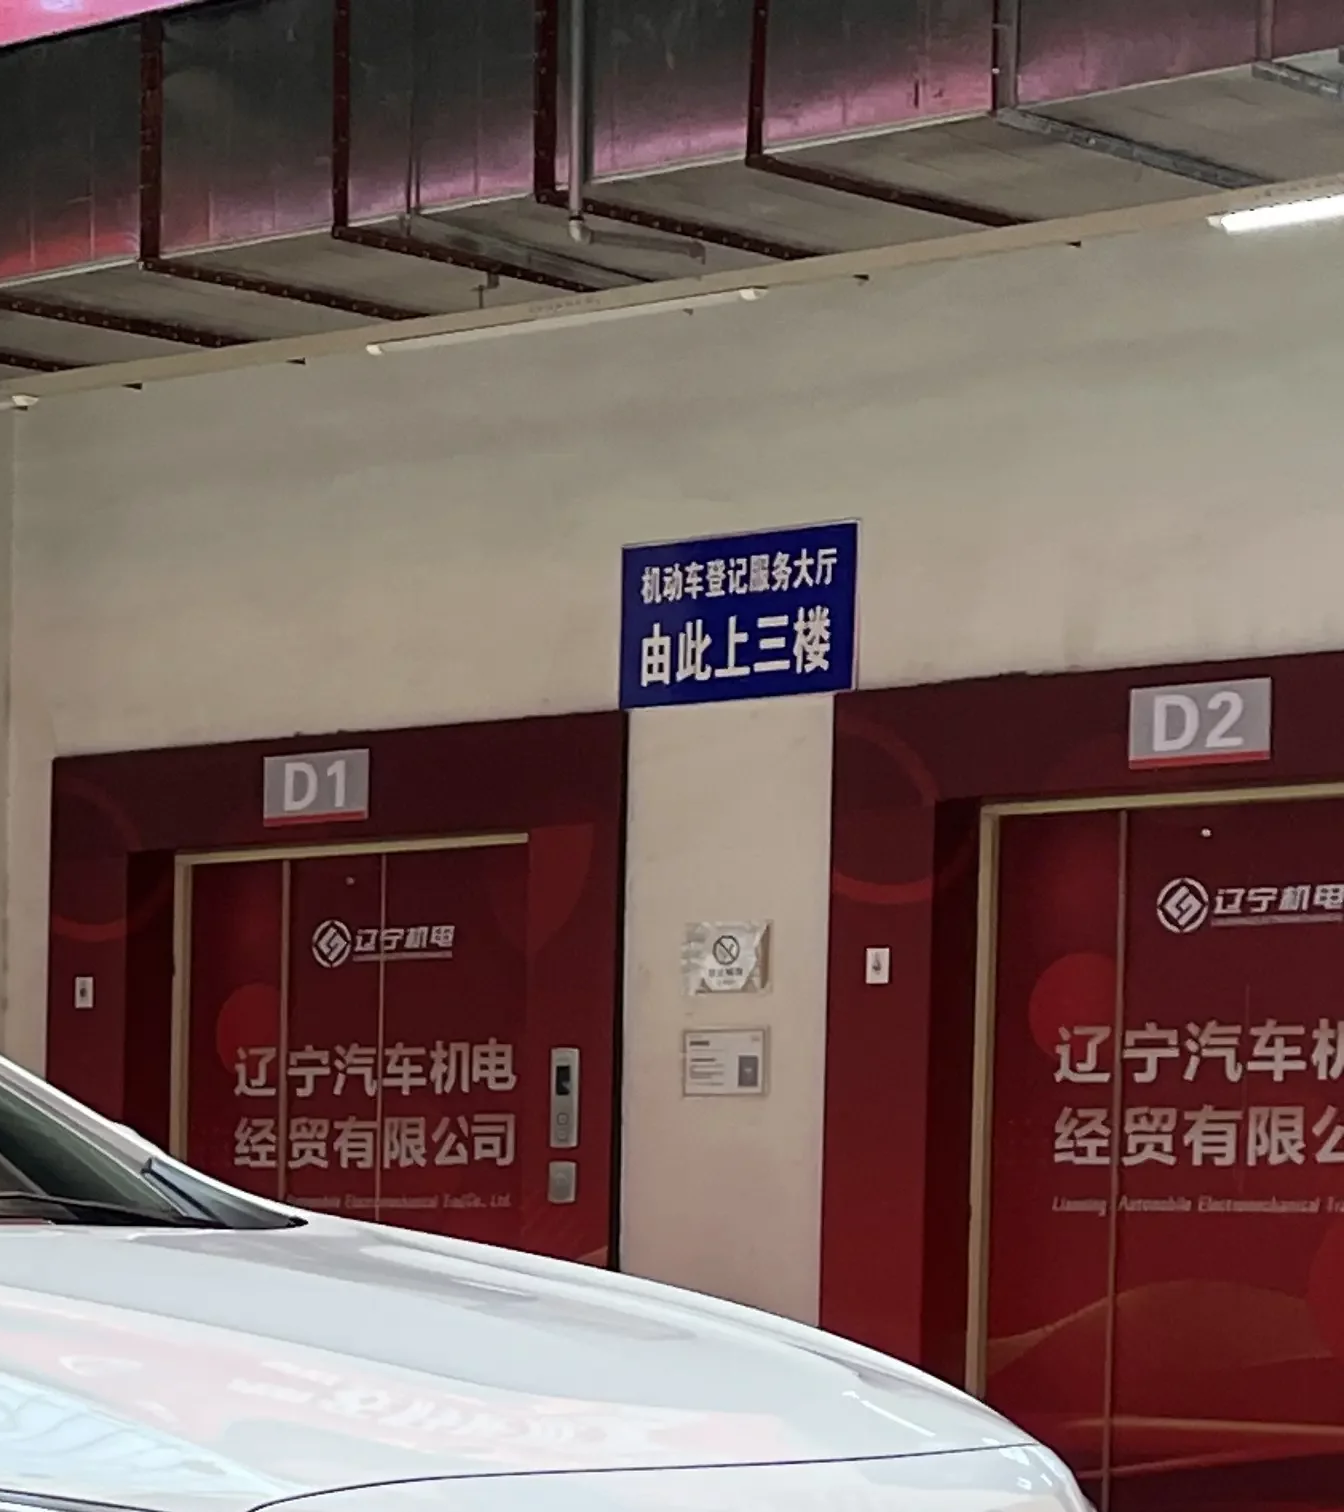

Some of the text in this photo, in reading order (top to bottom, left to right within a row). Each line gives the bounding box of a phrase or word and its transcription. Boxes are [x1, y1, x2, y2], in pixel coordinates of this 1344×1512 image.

[640, 547, 838, 605] 机动车登记服务大厅
[639, 604, 832, 688] 由此上三楼
[1152, 690, 1245, 753] D2
[282, 758, 347, 812] D1
[1214, 883, 1344, 915] 辽宁机电
[354, 924, 456, 953] 辽宁机电
[233, 1036, 518, 1098] 辽宁汽车机电
[233, 1113, 517, 1170] 经贸有限公司
